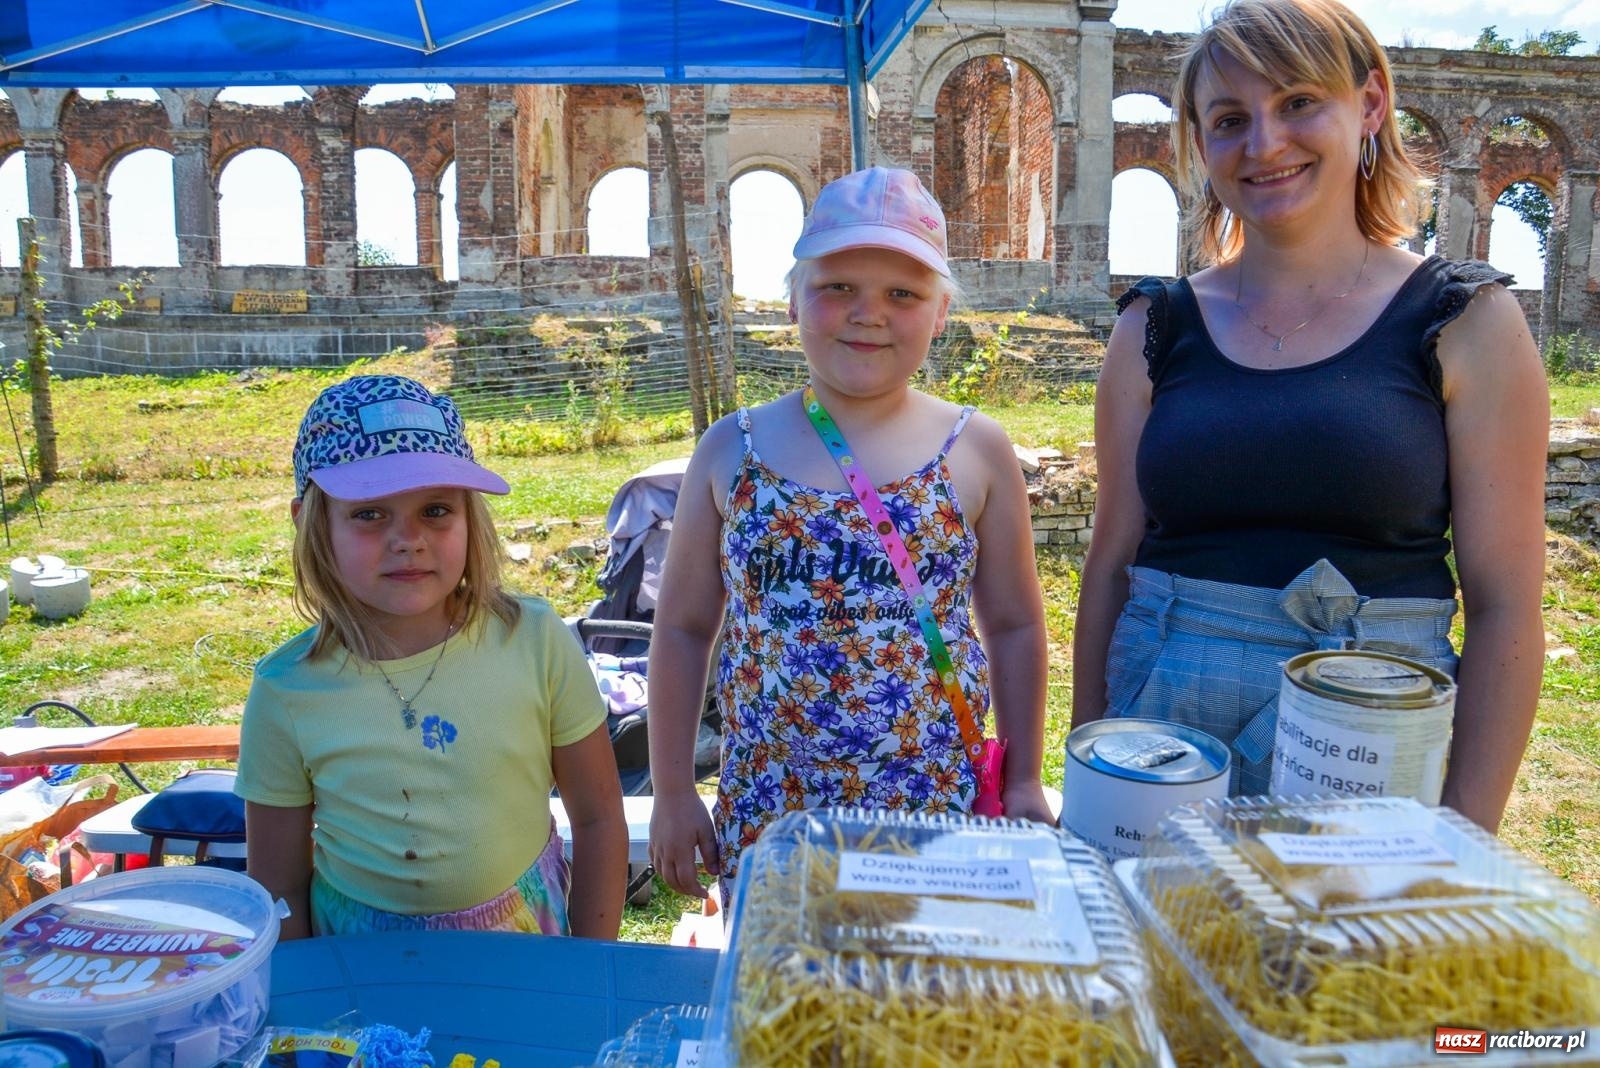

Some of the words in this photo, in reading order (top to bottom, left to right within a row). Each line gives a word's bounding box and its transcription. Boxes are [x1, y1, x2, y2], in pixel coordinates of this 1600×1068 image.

[383, 413, 434, 428] POWER
[815, 599, 870, 622] vibes
[1346, 745, 1379, 765] dla
[861, 856, 979, 878] Dziękujemy
[984, 865, 1009, 876] za
[851, 871, 917, 886] wasze
[922, 876, 1022, 893] wsparcie!
[47, 927, 96, 948] ONE
[91, 932, 209, 952] NUMBER
[278, 1038, 313, 1049] HOOK
[315, 1038, 347, 1051] TOOL
